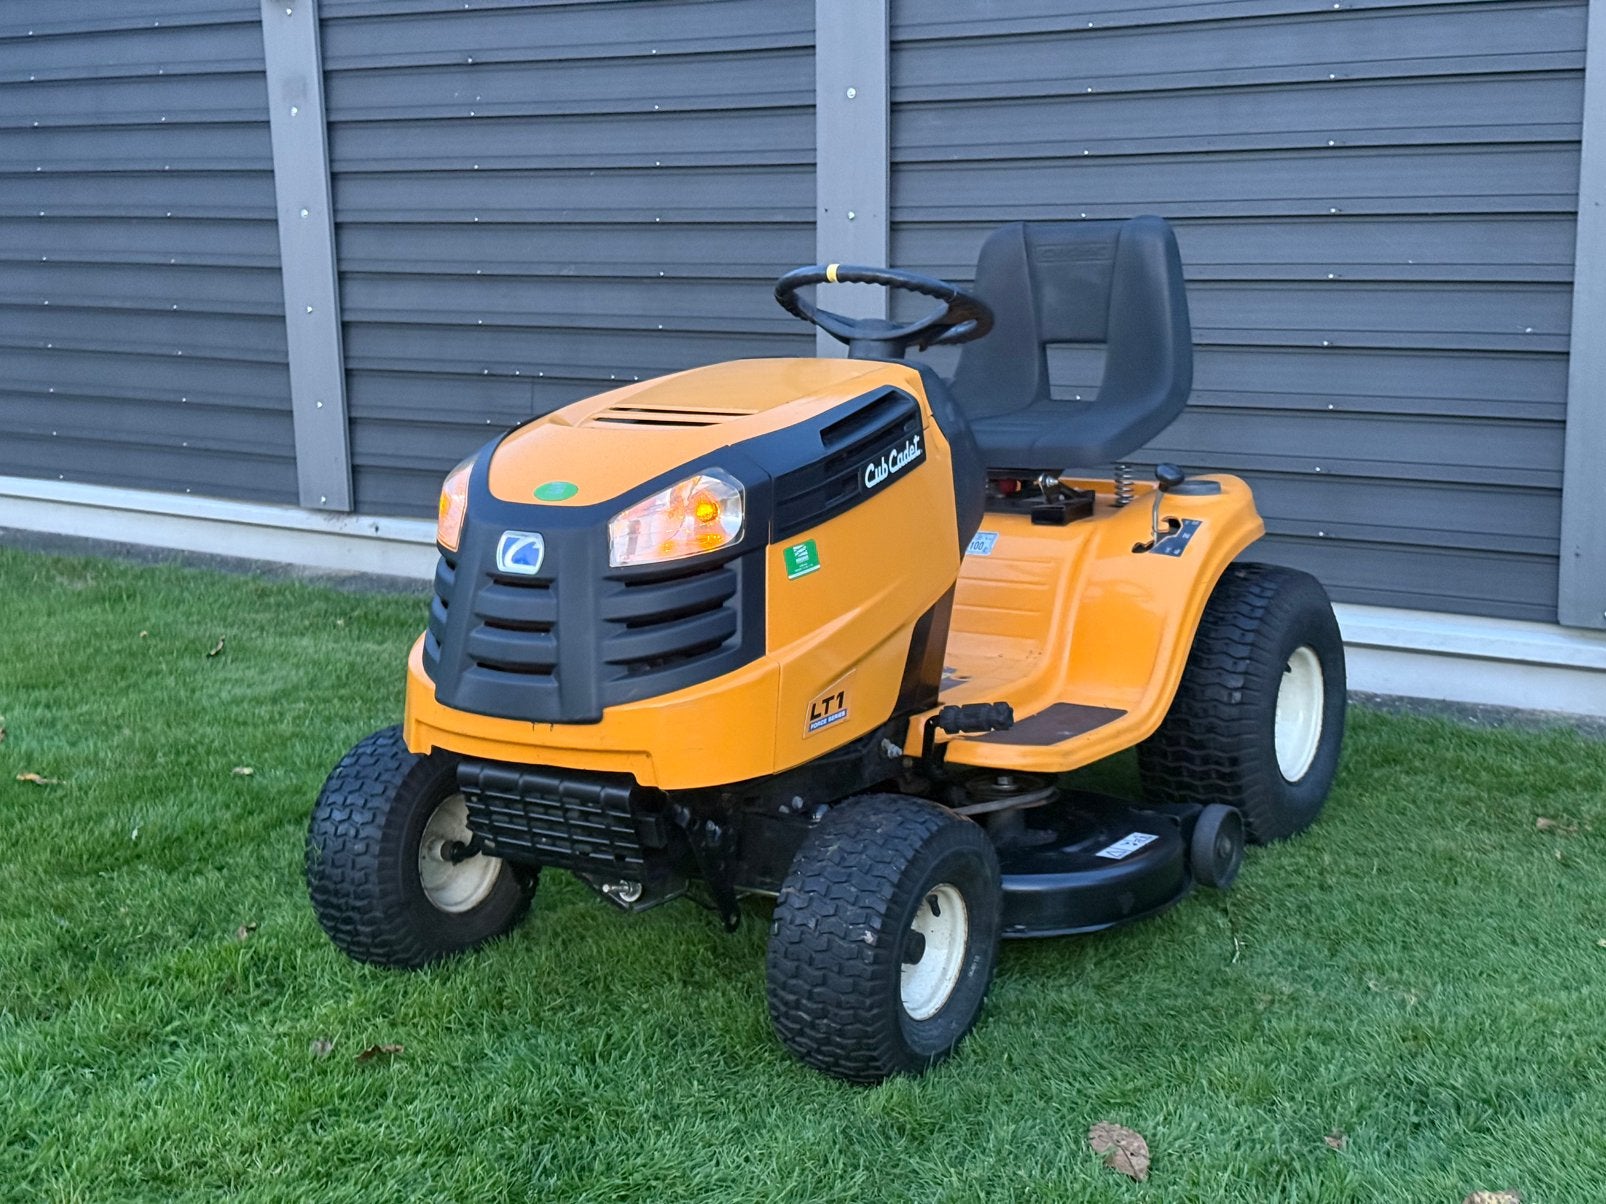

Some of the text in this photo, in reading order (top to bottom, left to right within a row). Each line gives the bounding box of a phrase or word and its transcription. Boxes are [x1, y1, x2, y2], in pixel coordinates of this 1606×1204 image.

[865, 435, 921, 489] Cub Cadet
[810, 691, 844, 721] LT1
